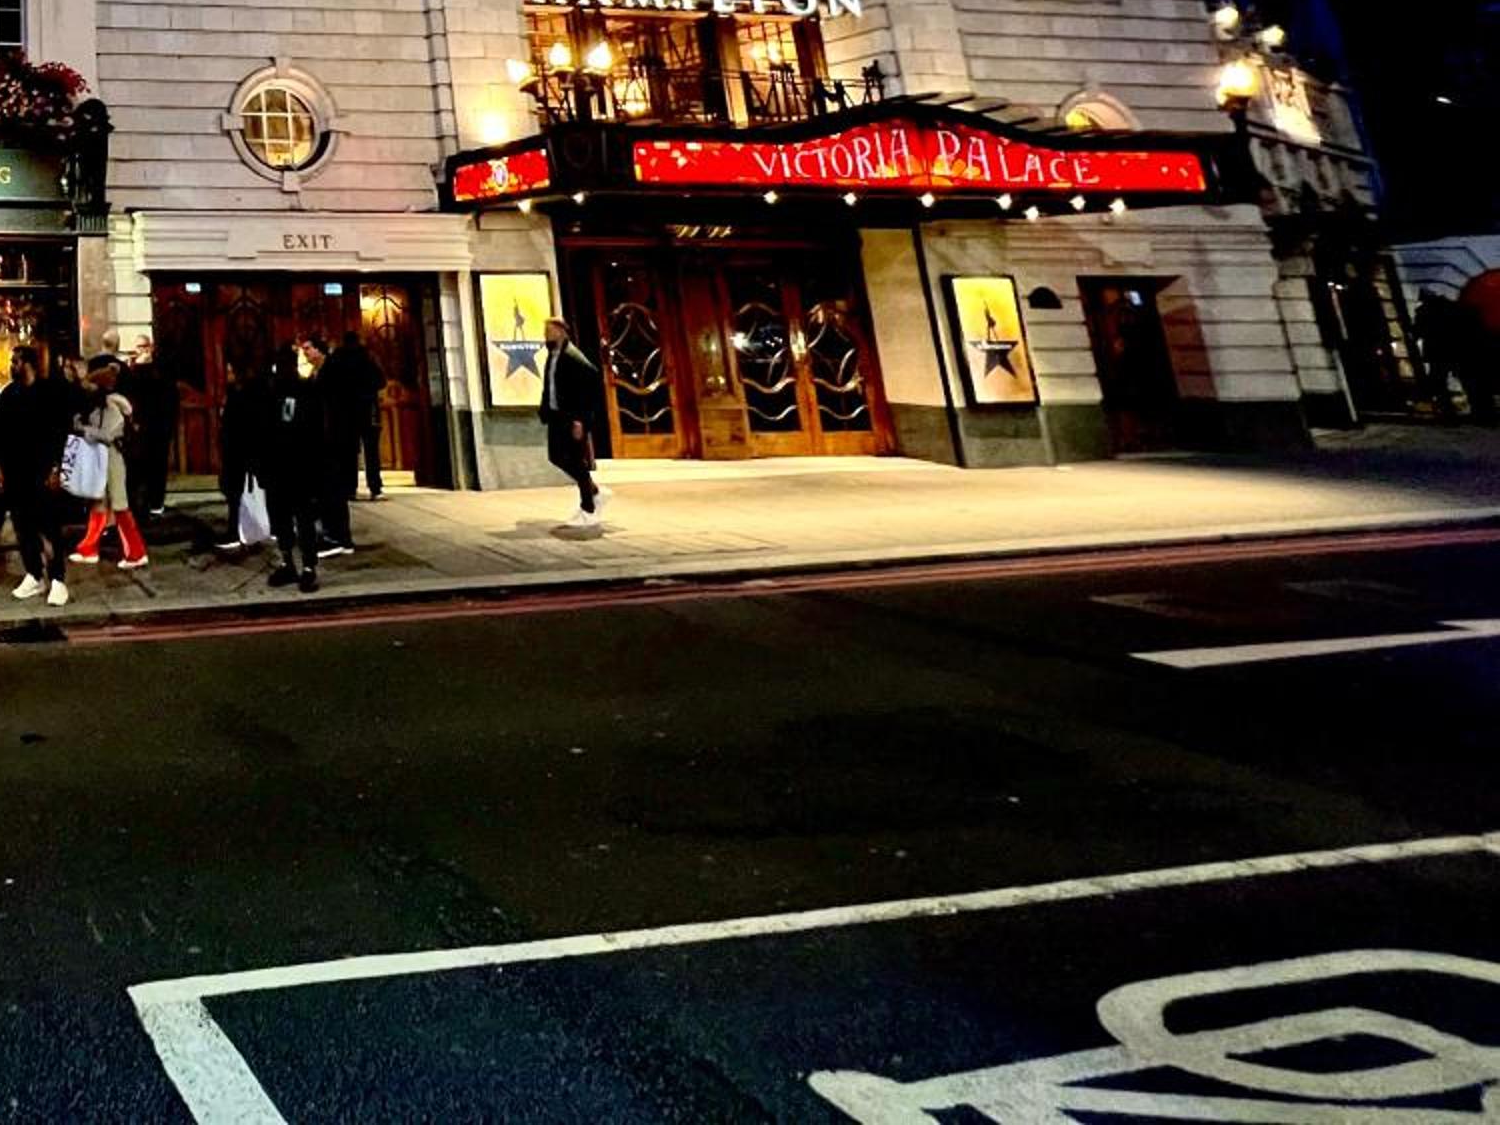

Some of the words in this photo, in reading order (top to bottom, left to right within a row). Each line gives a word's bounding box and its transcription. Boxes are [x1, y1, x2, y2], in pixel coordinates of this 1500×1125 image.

[753, 128, 911, 179] VICTORIA
[937, 129, 1100, 184] PALACE
[283, 234, 334, 250] EXIT
